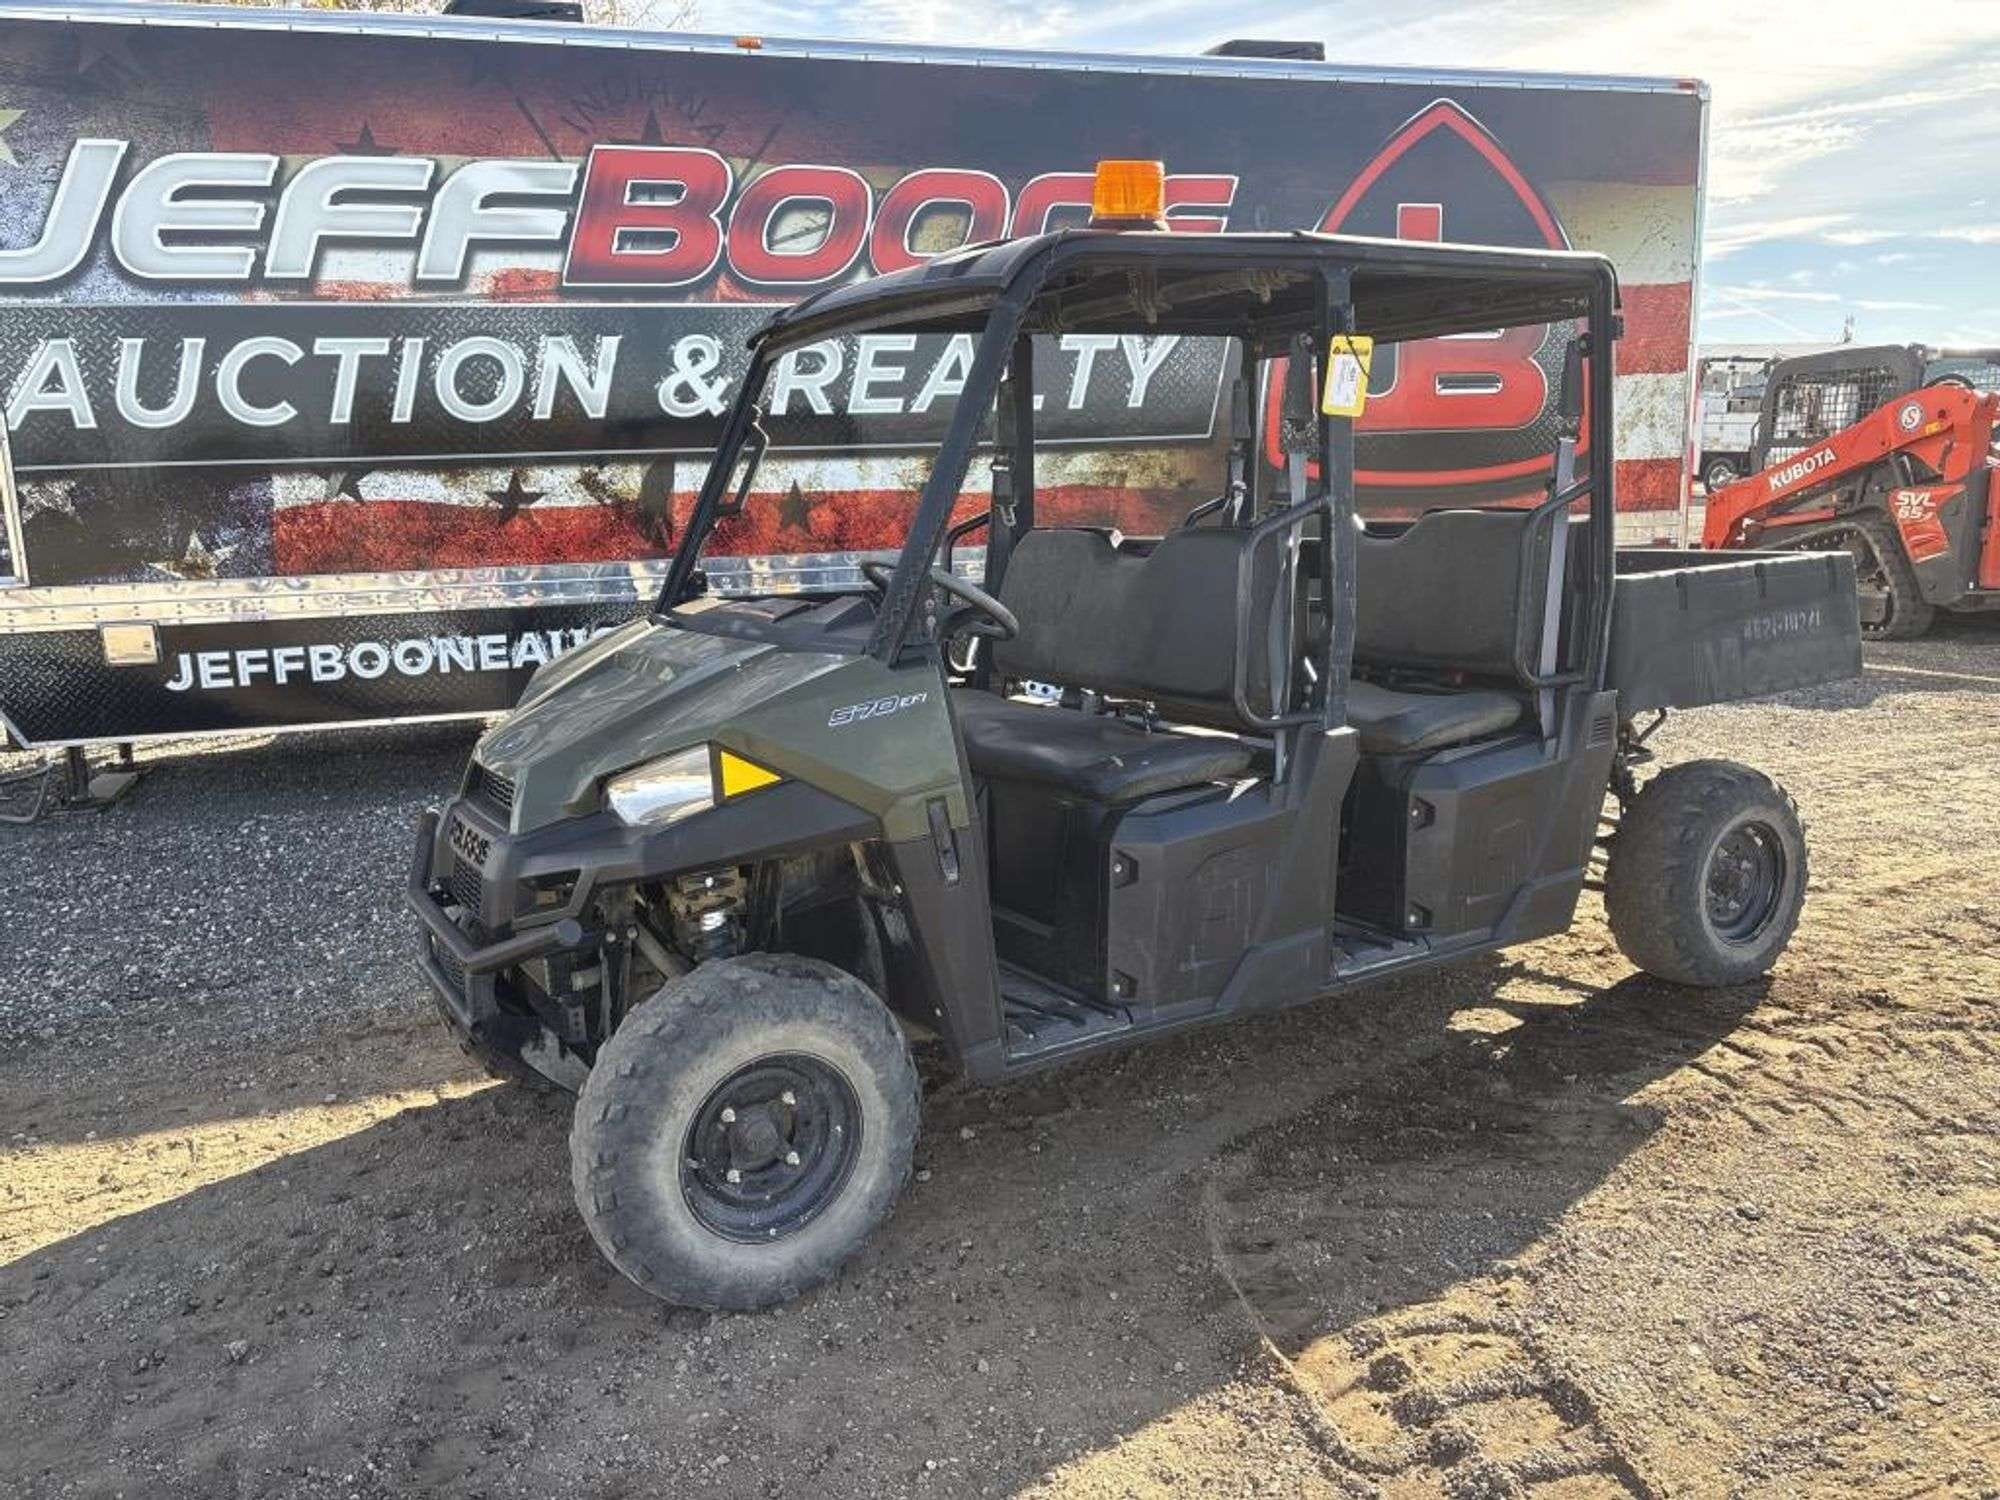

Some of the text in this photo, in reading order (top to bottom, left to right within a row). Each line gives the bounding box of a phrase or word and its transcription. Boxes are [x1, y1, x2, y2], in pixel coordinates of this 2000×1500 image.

[8, 332, 1182, 430] AUCTION & REATY
[1768, 447, 1836, 491] KUBOTA
[1894, 491, 1937, 507] SVL
[165, 626, 616, 692] JEFFBOONEAU
[828, 694, 899, 727] 570
